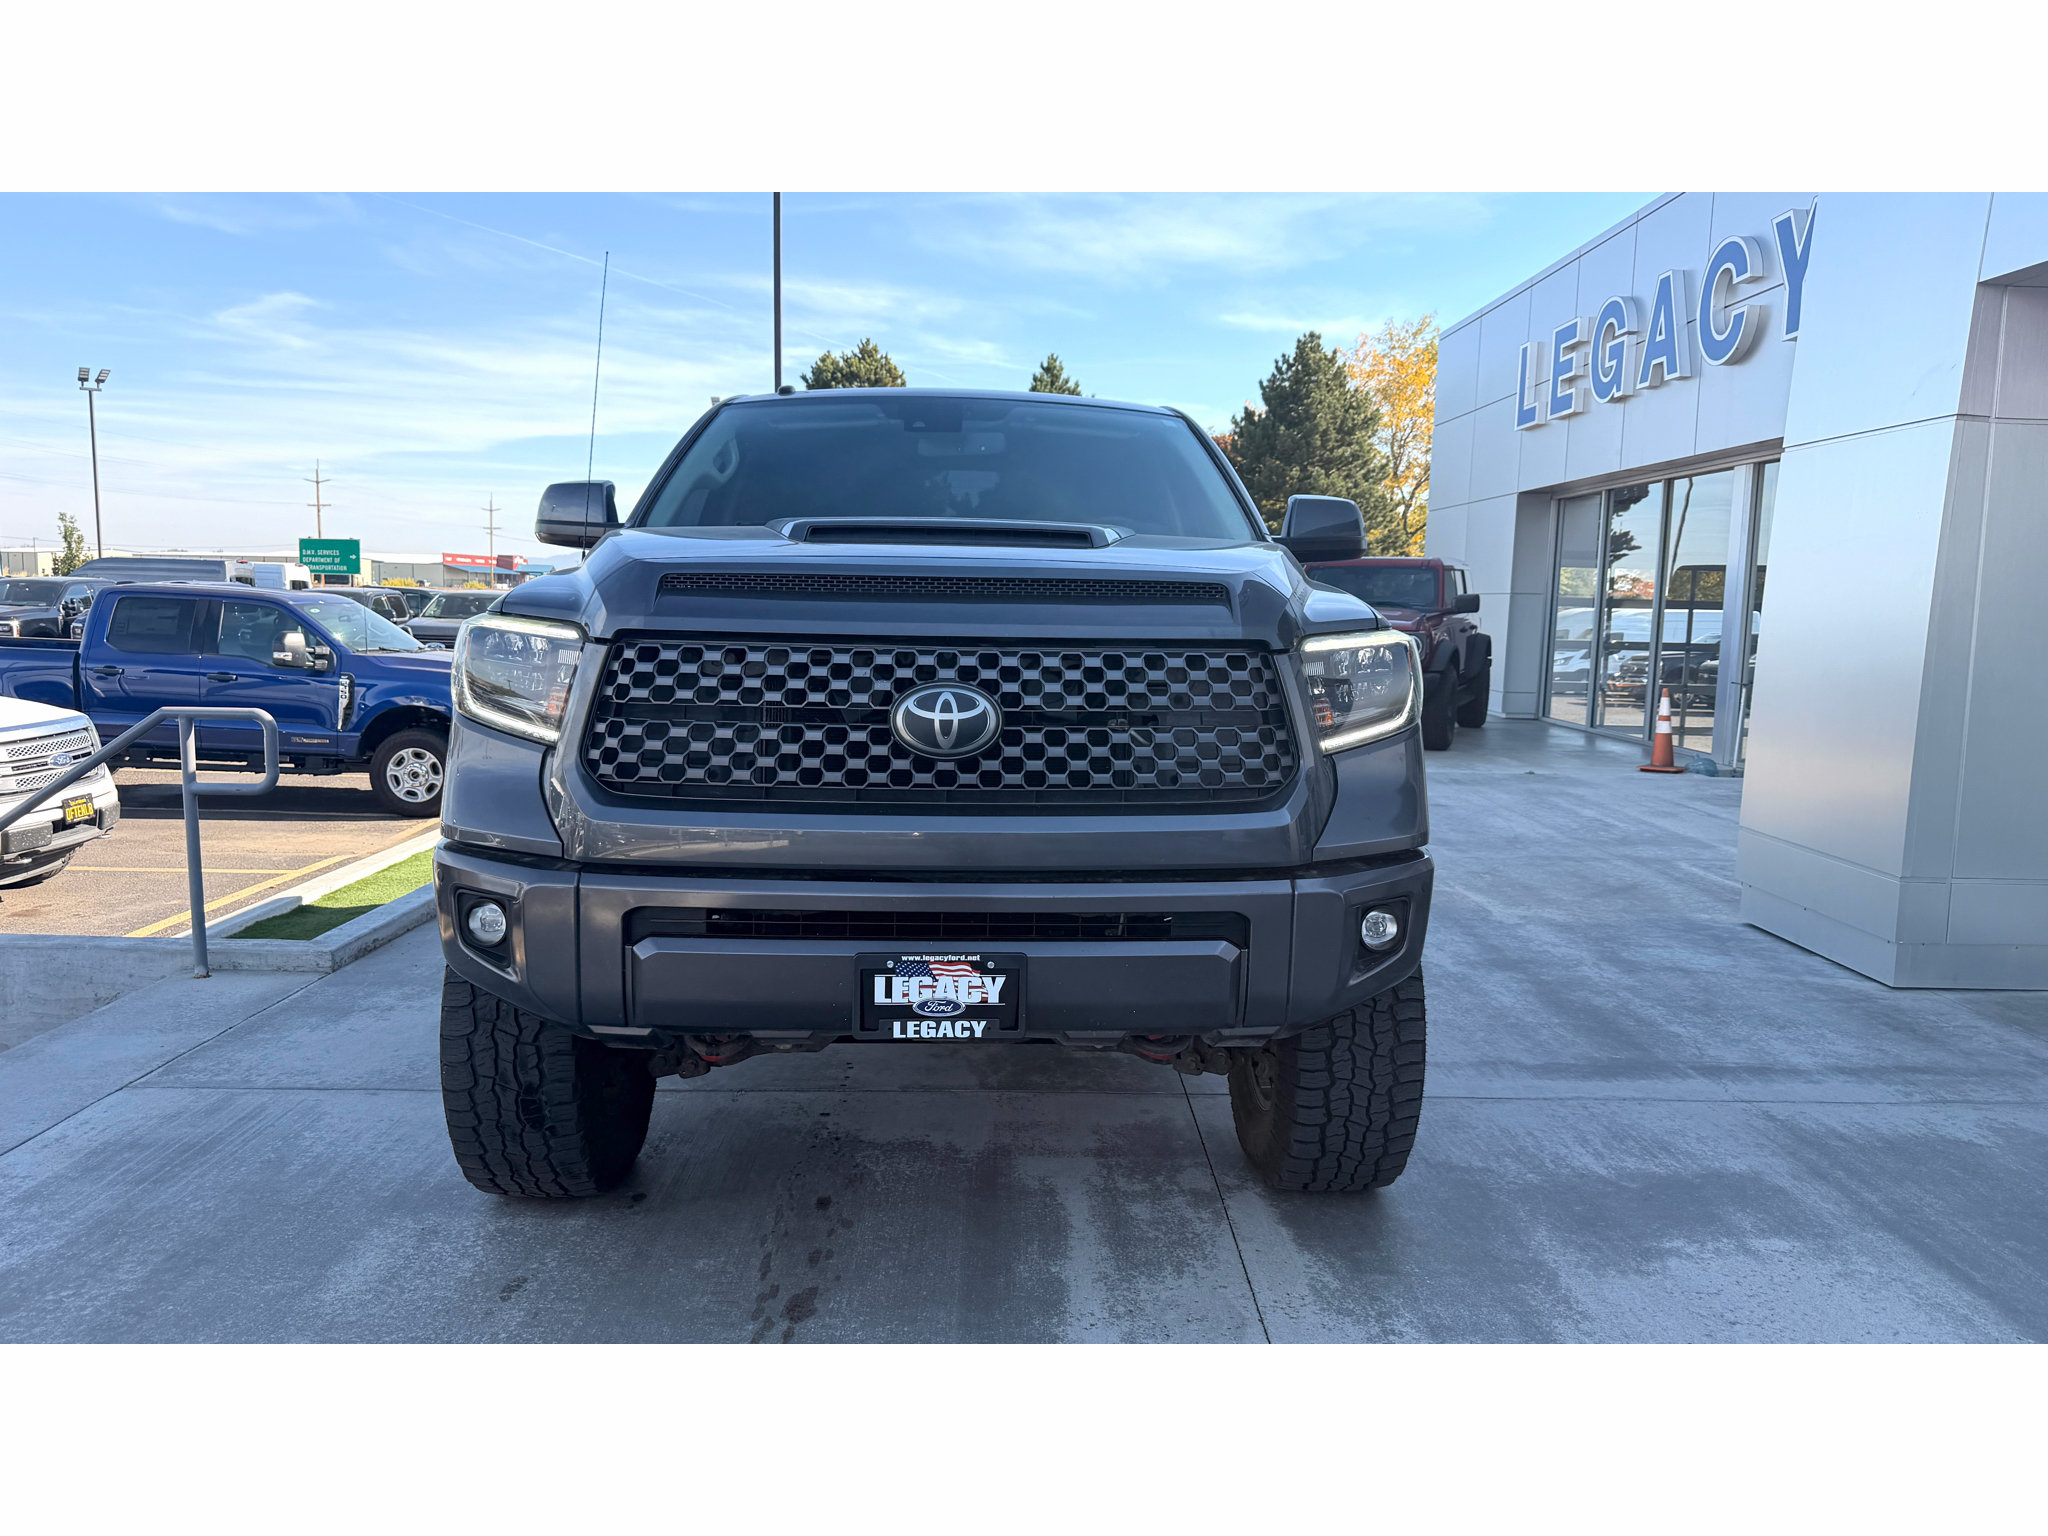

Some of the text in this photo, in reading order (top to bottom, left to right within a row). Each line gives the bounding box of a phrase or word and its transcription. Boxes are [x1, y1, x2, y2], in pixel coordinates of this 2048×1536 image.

[1514, 194, 1819, 431] LEGACY
[901, 954, 981, 962] www.legacyford.net
[874, 976, 1006, 1004] LEGACY
[924, 1001, 954, 1013] Ford
[893, 1020, 987, 1039] LEGACY
